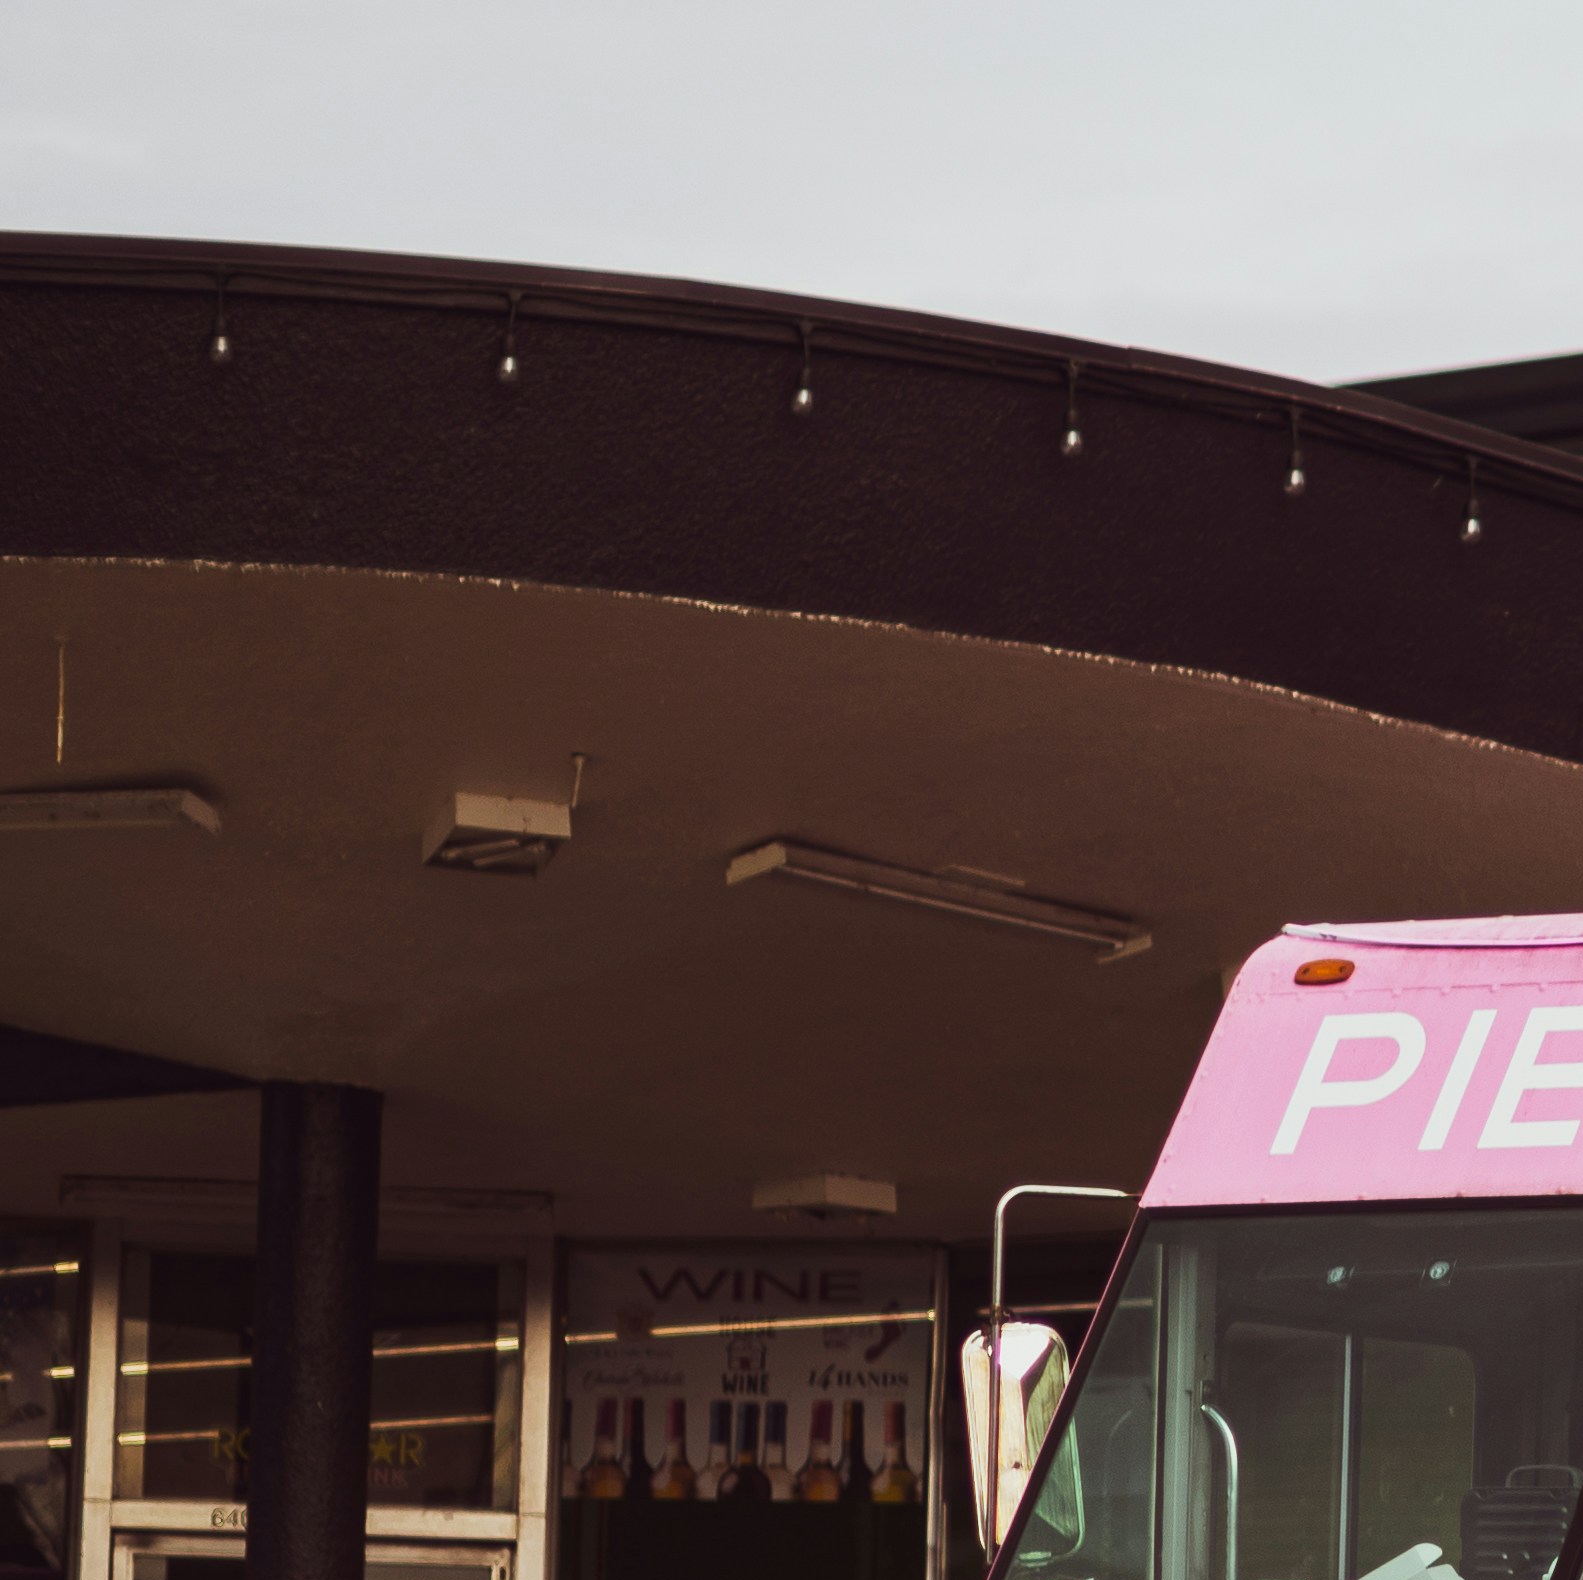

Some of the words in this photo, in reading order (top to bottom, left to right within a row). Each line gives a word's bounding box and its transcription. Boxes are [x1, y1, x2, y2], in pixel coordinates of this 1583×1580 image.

[640, 1269, 860, 1302] WINE
[721, 1373, 770, 1395] WINE
[838, 1370, 909, 1388] HANDS
